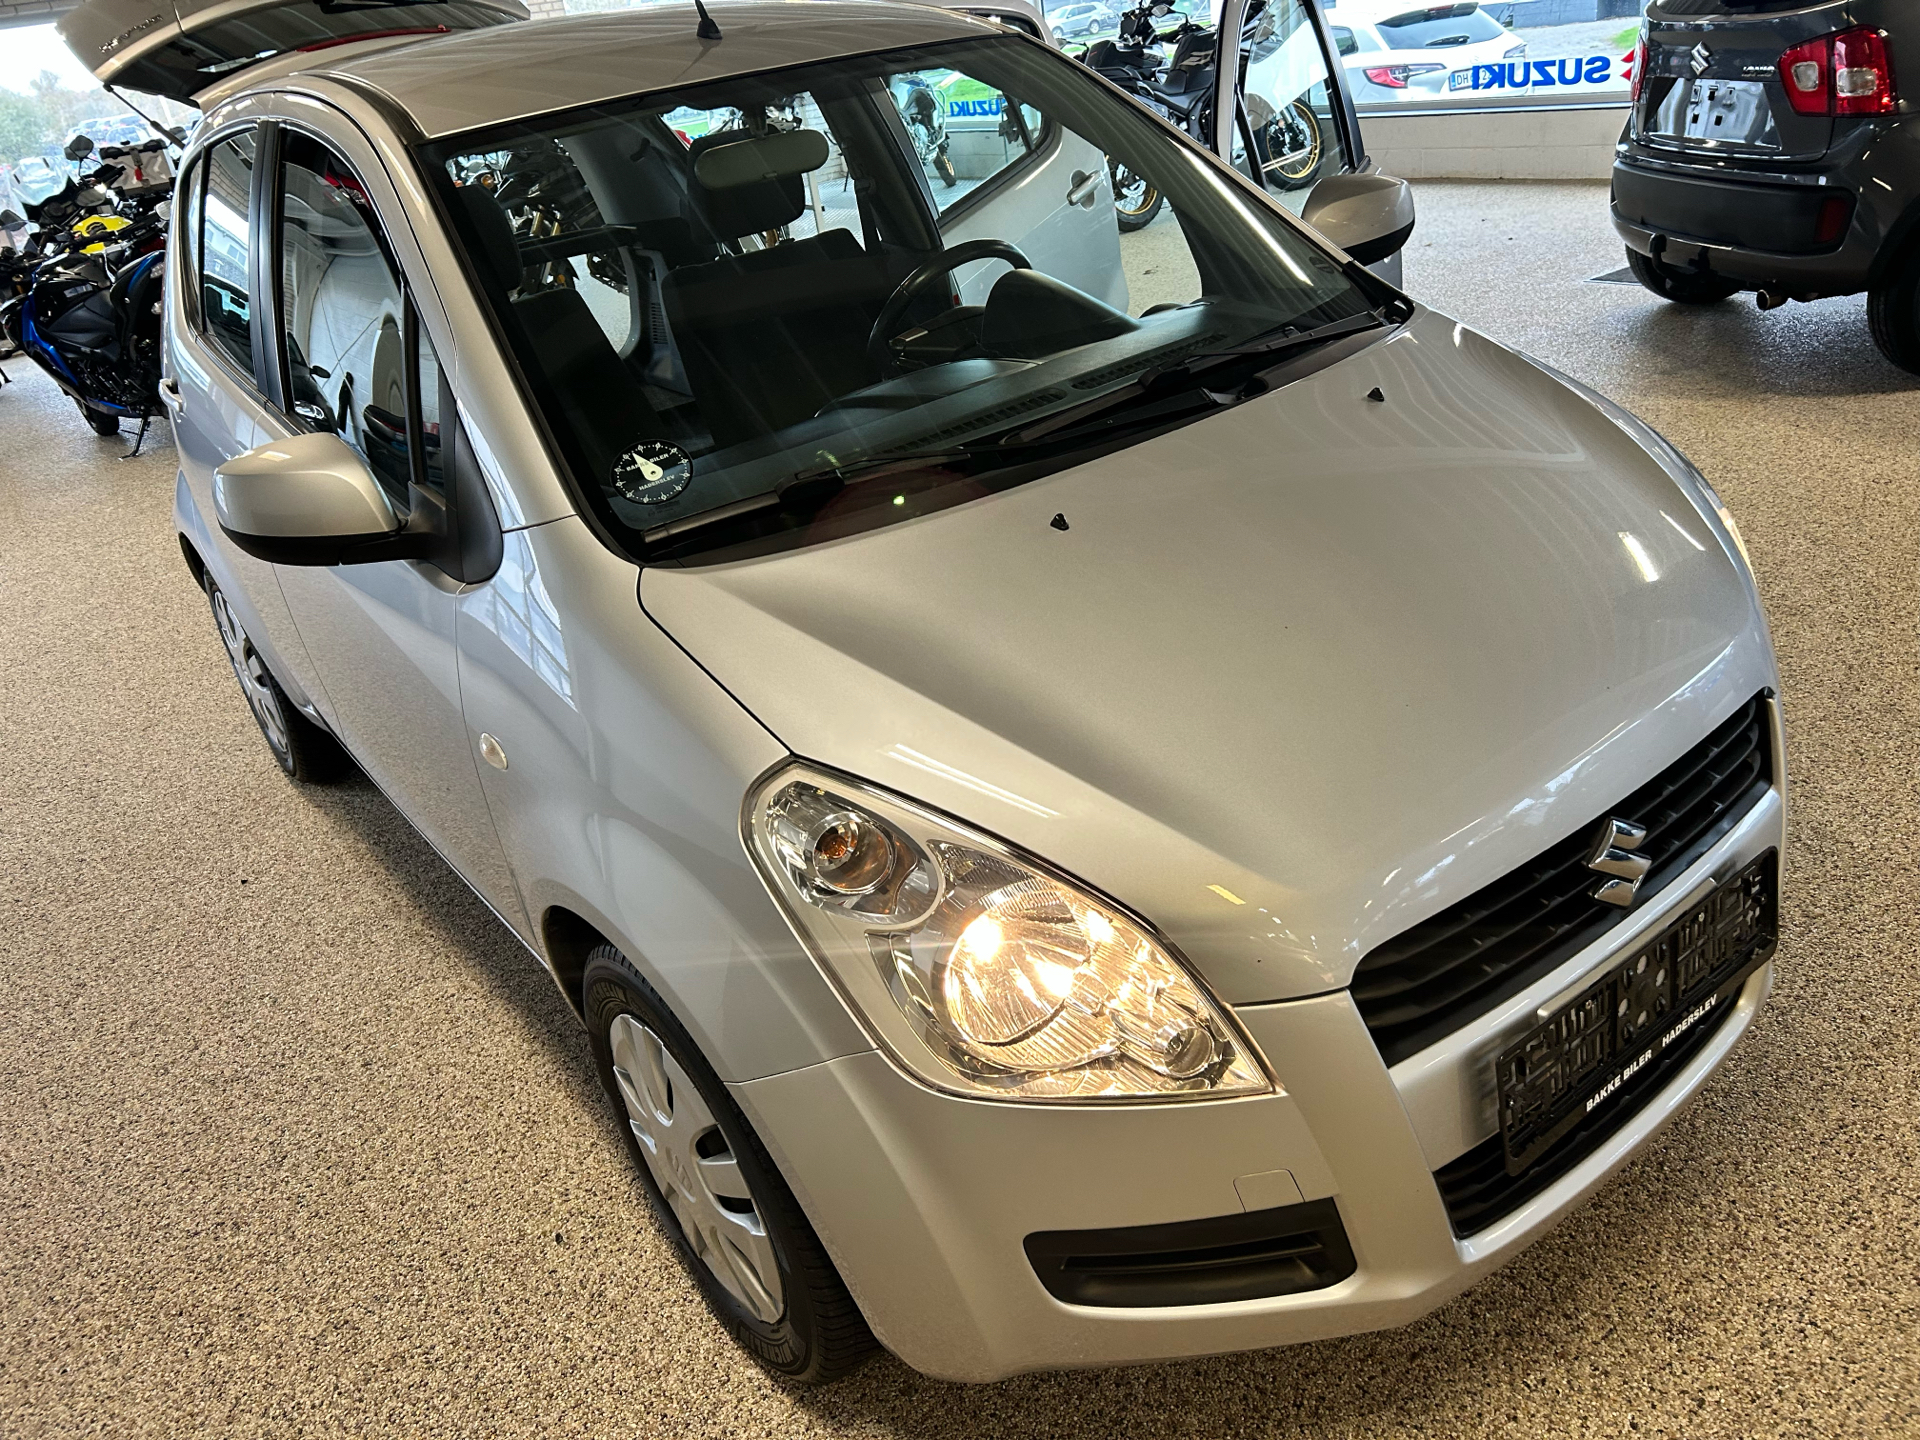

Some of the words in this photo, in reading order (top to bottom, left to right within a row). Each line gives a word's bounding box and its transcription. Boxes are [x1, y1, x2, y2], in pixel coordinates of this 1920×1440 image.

[649, 453, 669, 463] BILER
[638, 474, 676, 491] HADERSLEV
[1586, 1073, 1621, 1112] BAKKE
[1623, 1049, 1652, 1081] BILER
[1662, 994, 1717, 1047] HADERSLEV
